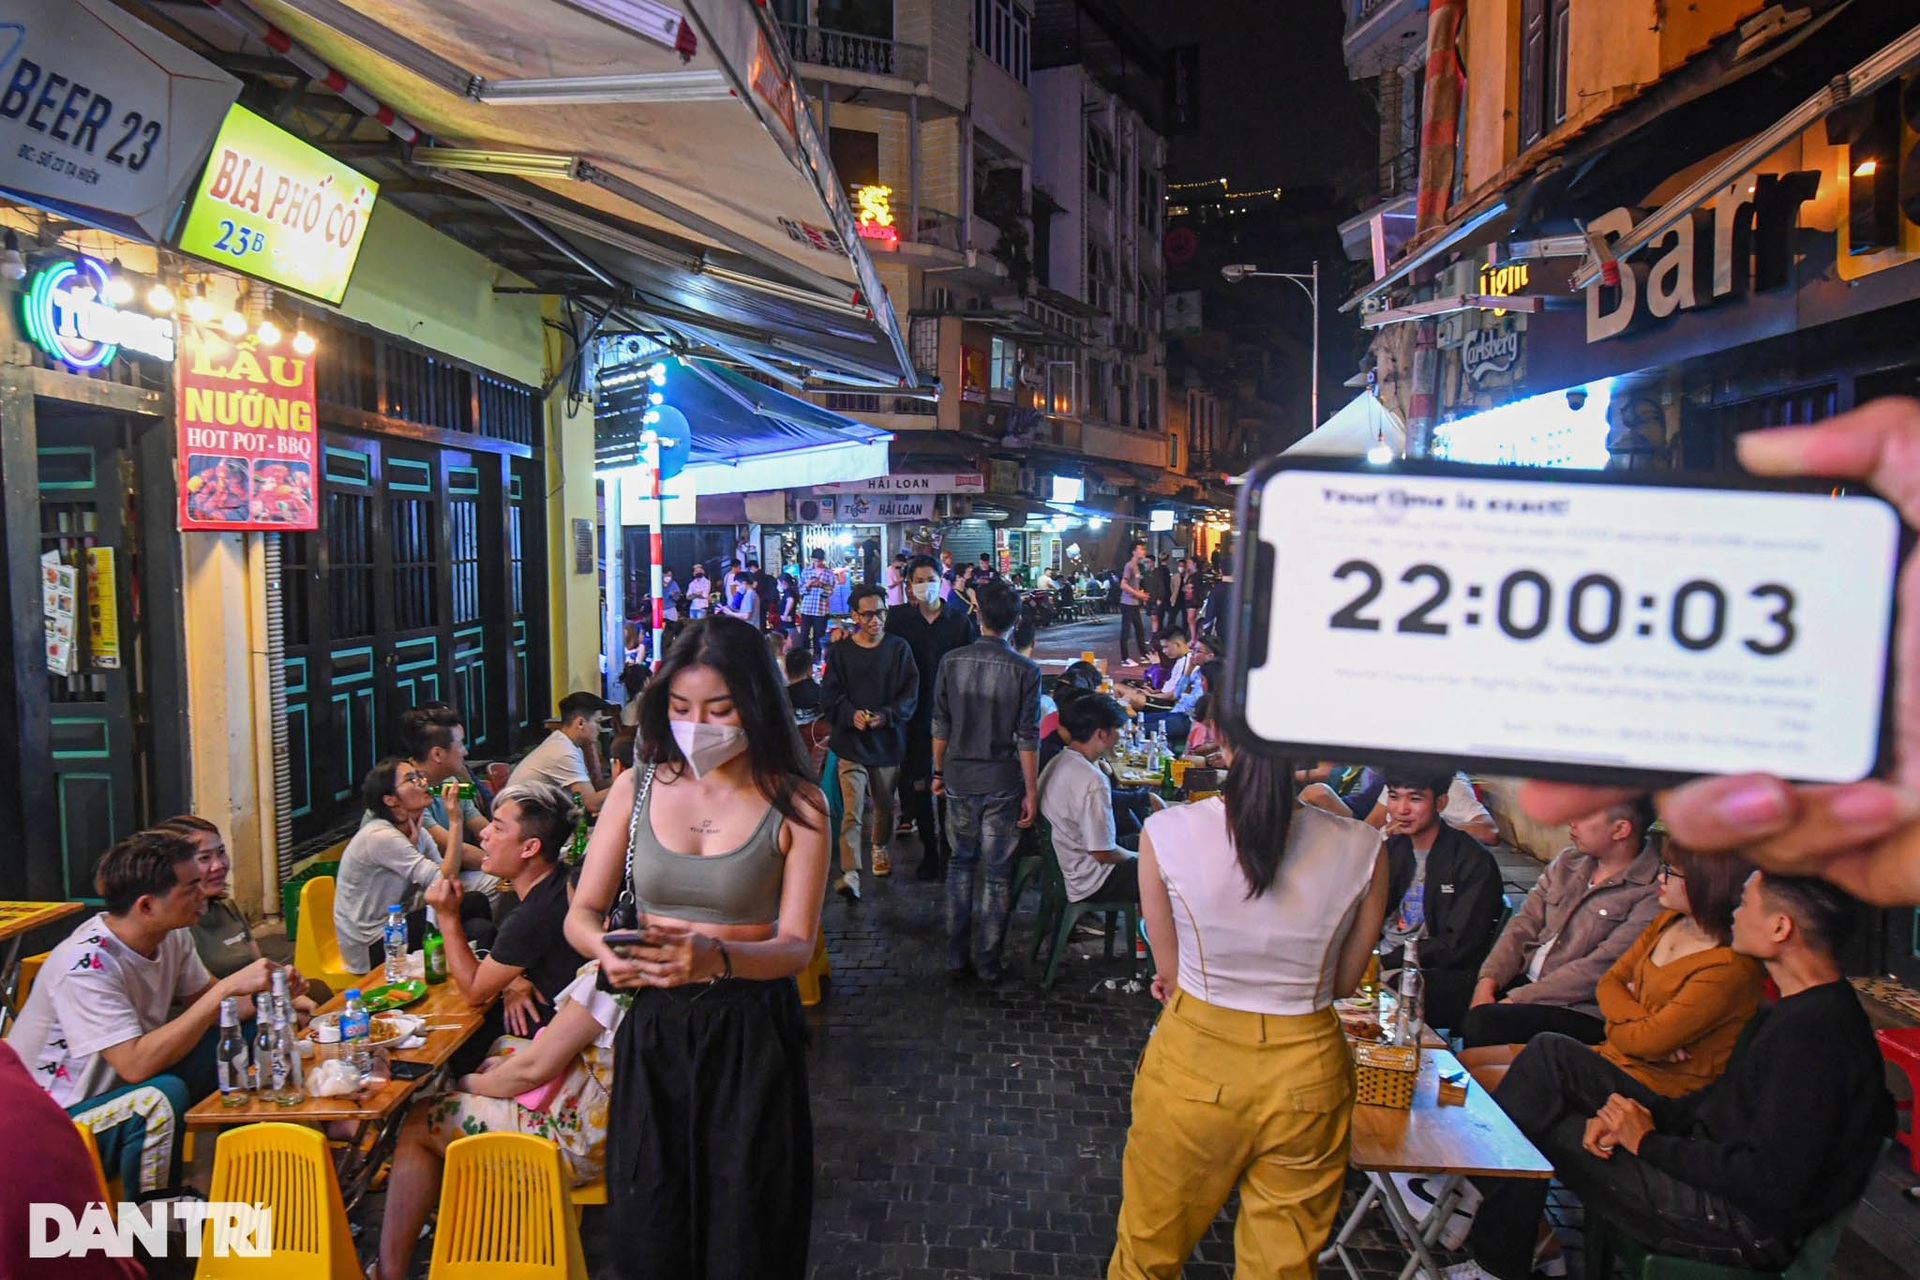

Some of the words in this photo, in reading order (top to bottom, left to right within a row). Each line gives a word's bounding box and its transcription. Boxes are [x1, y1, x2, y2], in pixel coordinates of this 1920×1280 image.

[0, 58, 113, 152] BEER
[106, 111, 161, 171] 23
[210, 150, 263, 213] BIA
[266, 174, 333, 233] PHỐ
[190, 333, 307, 387] LẨU
[1463, 330, 1517, 373] Carlsberg
[185, 388, 312, 432] NƯỚNG
[187, 427, 229, 449] HOT
[276, 436, 312, 459] BBQ
[896, 479, 929, 489] LOAN
[844, 504, 869, 517] Tiger
[898, 503, 923, 516] LOAN
[1328, 557, 1798, 657] 22:00:03
